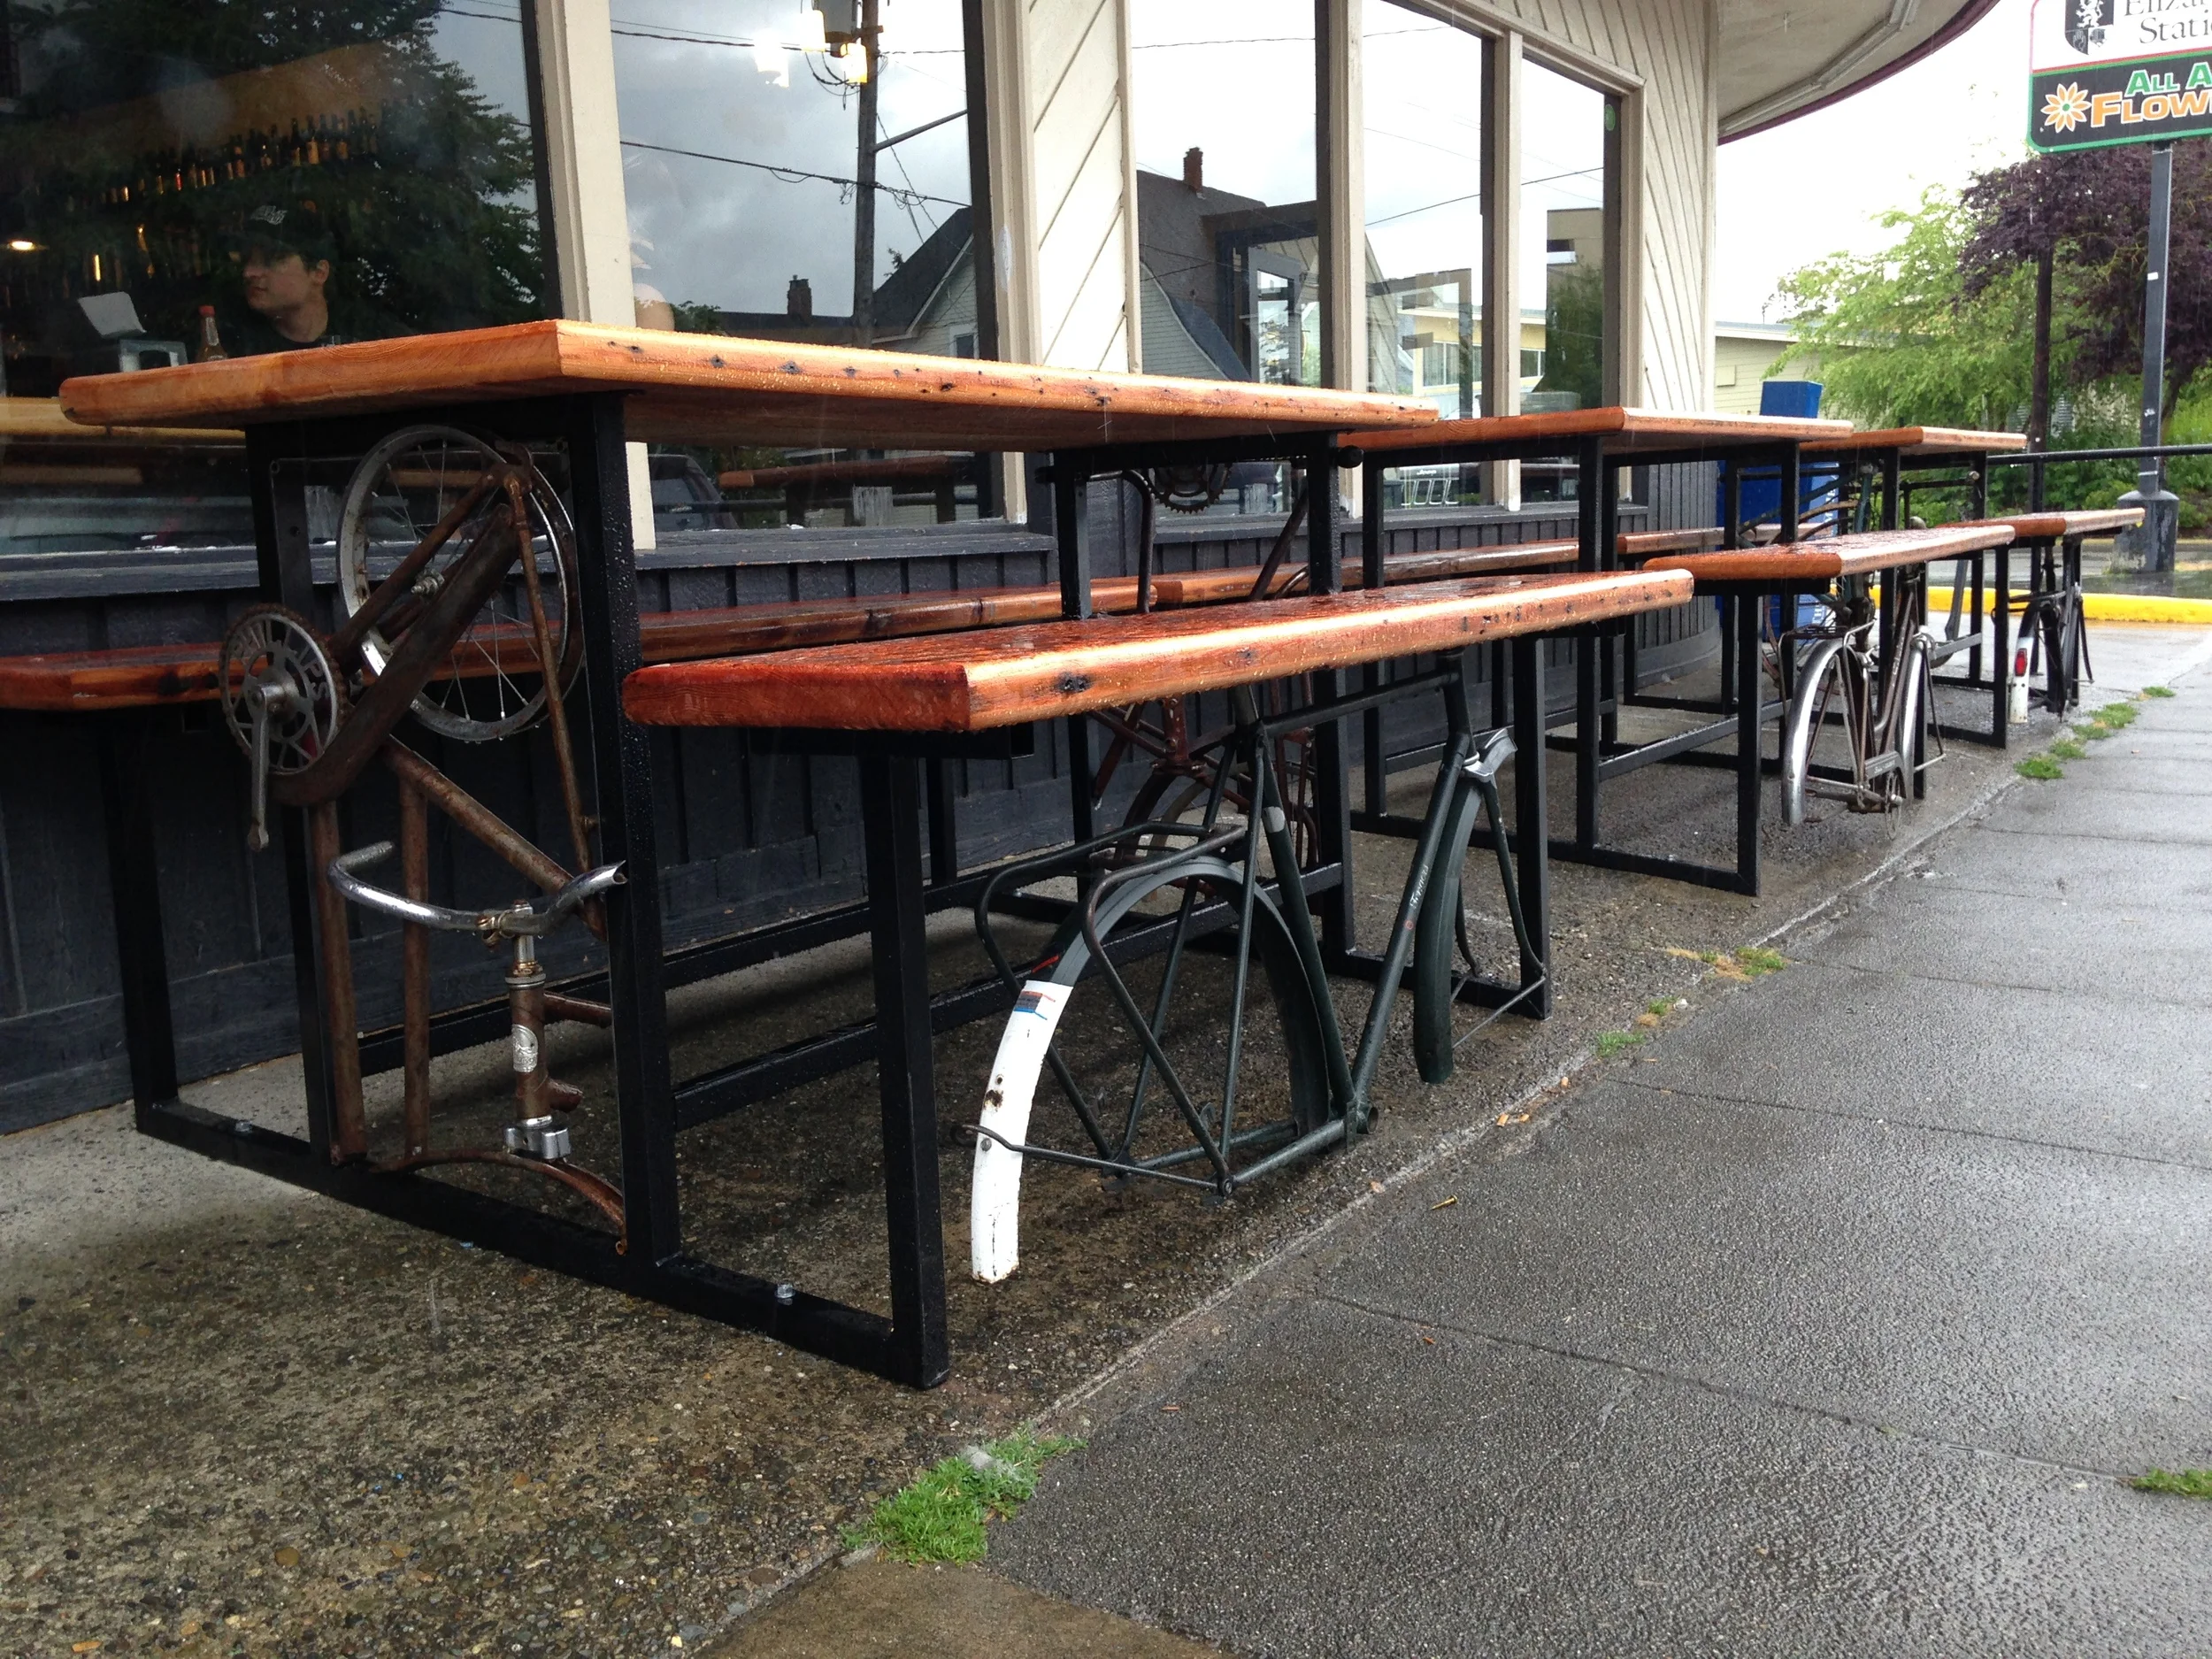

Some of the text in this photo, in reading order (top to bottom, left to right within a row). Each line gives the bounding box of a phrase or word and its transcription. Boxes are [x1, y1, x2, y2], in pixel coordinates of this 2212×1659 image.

[2139, 10, 2212, 43] Stati
[2124, 69, 2180, 96] ALL
[2091, 89, 2212, 127] FLOW
